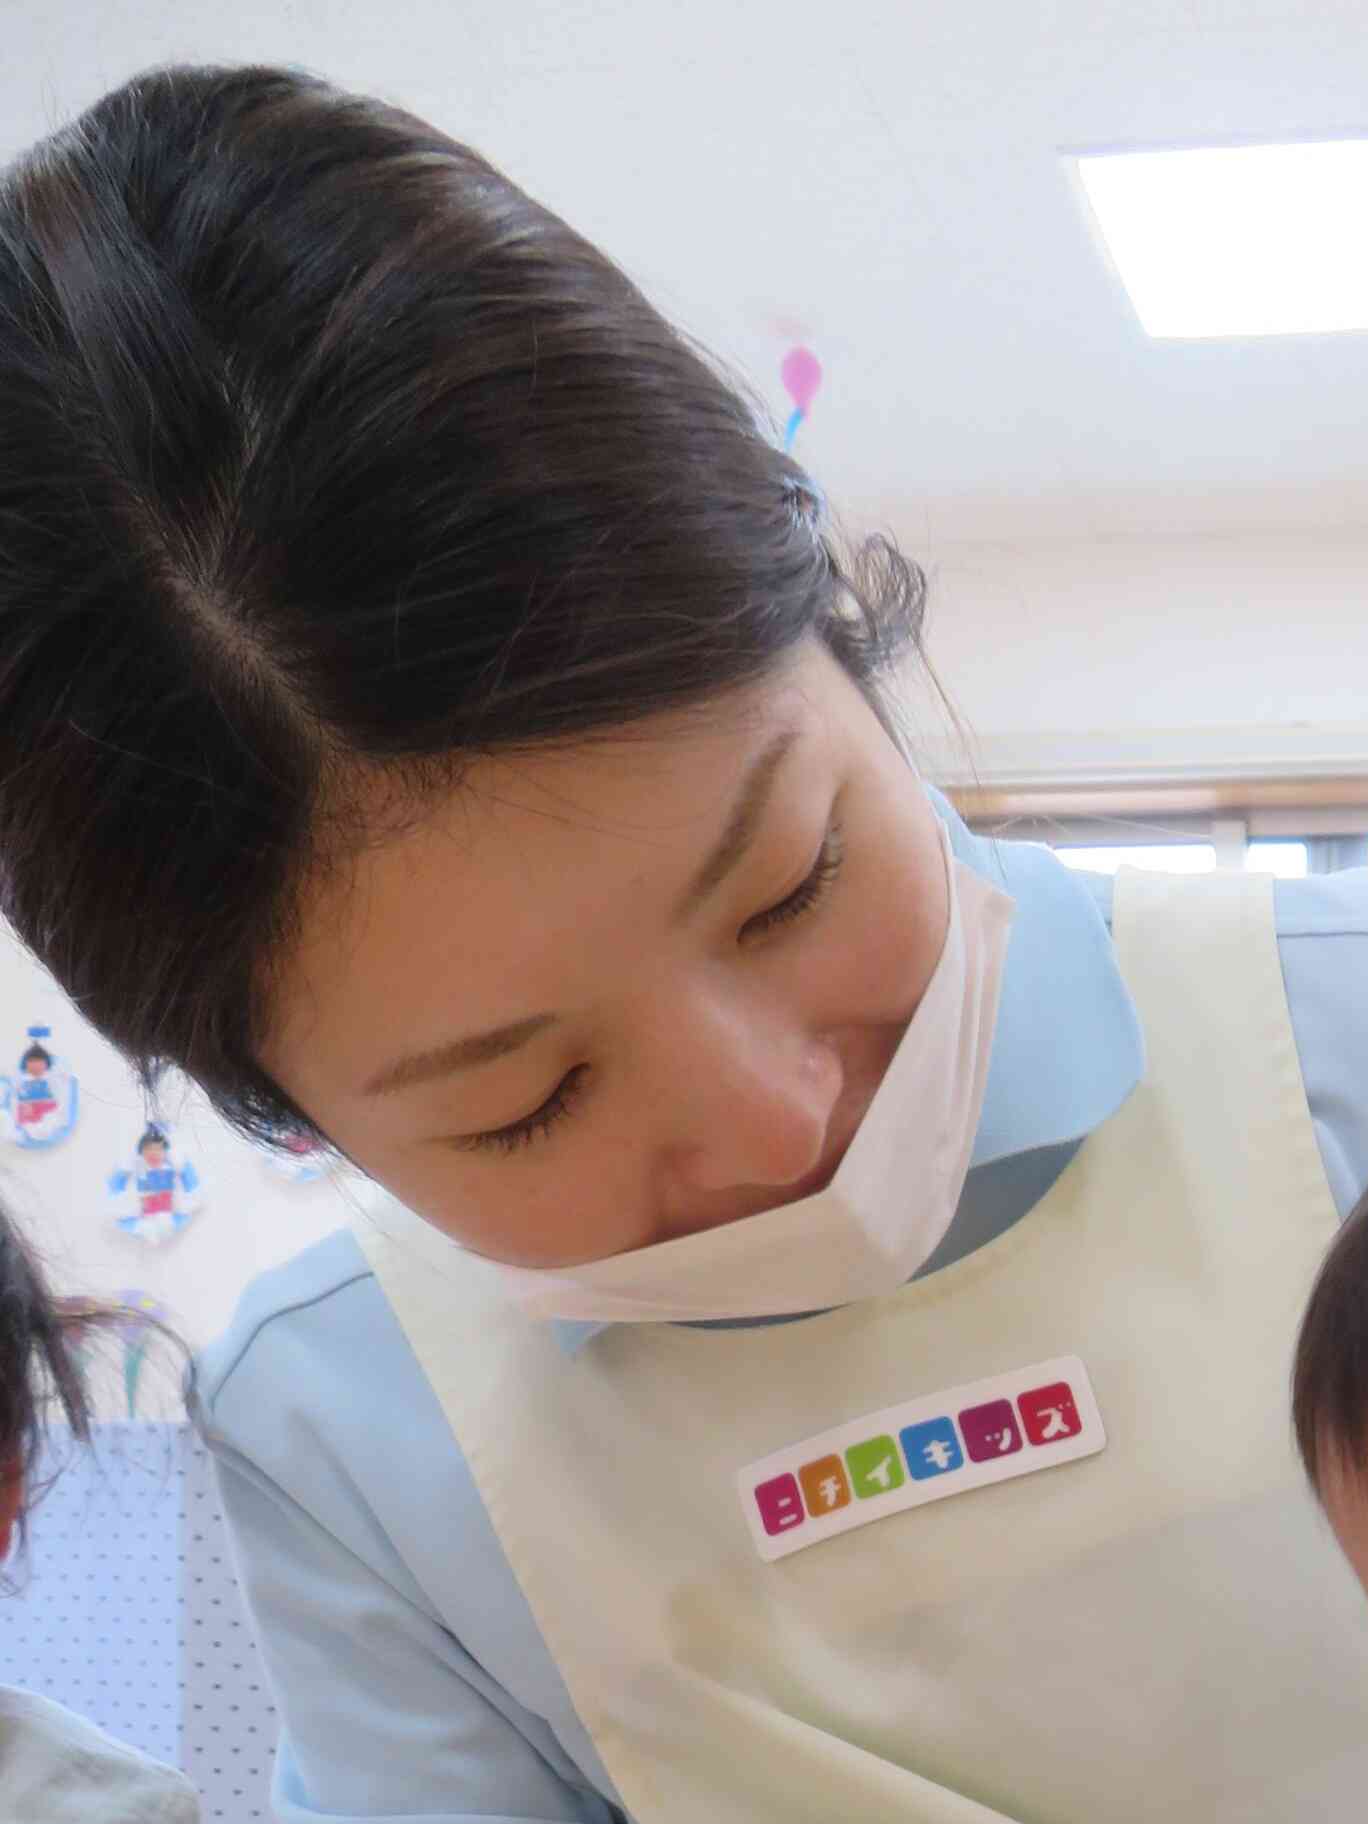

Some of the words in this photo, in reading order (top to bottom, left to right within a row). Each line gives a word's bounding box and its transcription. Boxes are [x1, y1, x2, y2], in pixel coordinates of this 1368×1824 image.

[777, 1400, 1073, 1525] ニチイキッズ
